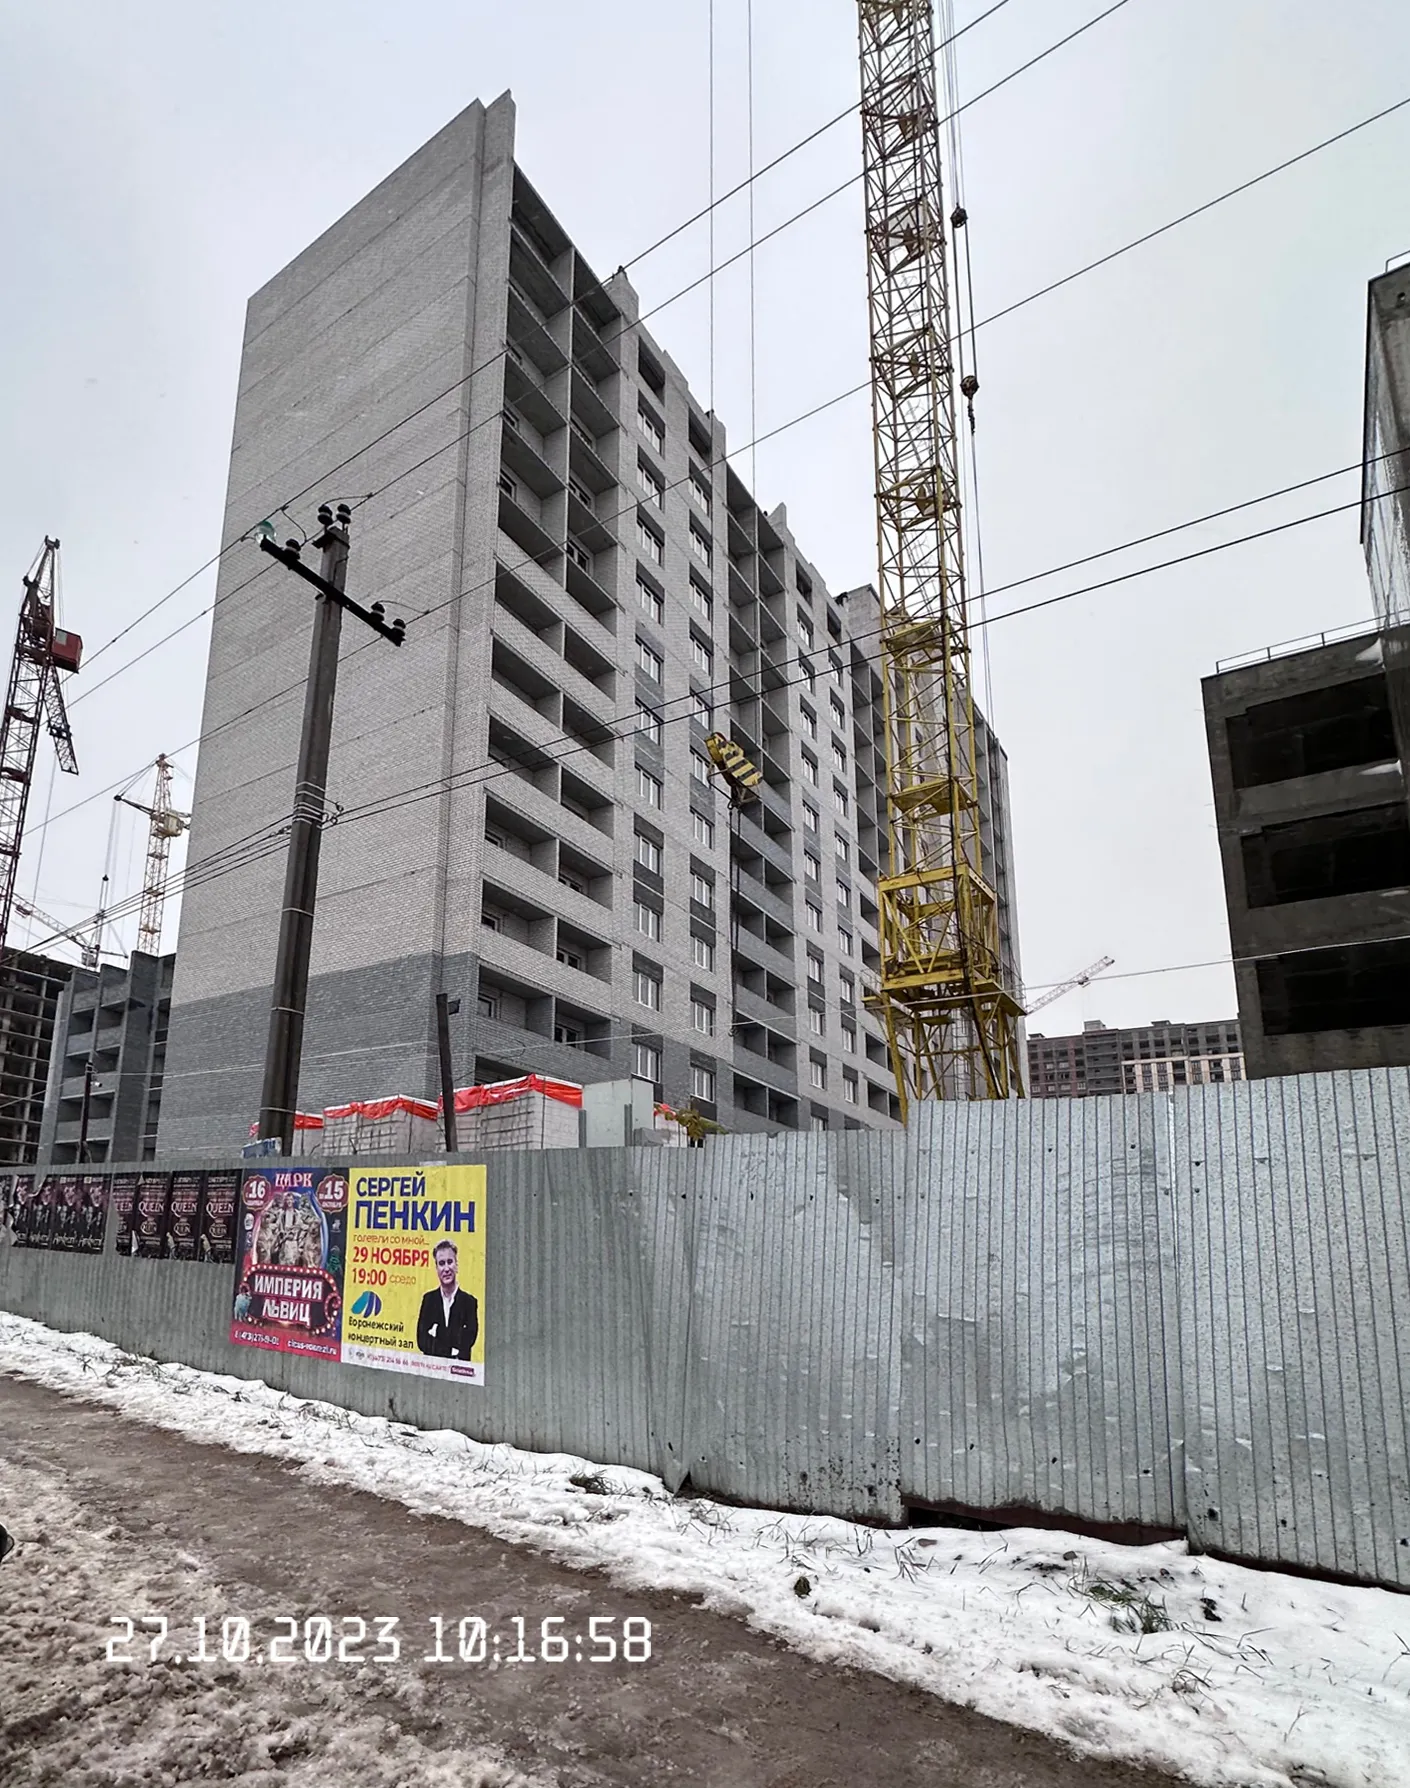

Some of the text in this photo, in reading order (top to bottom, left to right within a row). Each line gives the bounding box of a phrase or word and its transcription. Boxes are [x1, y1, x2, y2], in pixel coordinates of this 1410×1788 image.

[249, 1181, 266, 1198] 16
[324, 1181, 344, 1200] 15
[356, 1171, 426, 1197] СЕРГЕЙ
[139, 1201, 164, 1217] QUEEN
[171, 1201, 198, 1218] QUEEN
[206, 1201, 234, 1219] QUEEN
[354, 1200, 476, 1233] ПЕНКИН
[390, 1235, 401, 1244] со
[353, 1246, 430, 1267] 29 НОЯБРЯ
[352, 1268, 387, 1286] 19:00
[254, 1274, 323, 1300] ИМПЕРИЯ
[262, 1298, 311, 1327] ЛЬВИЦ
[349, 1316, 404, 1333] Воронежский
[348, 1332, 414, 1349] концертный зал
